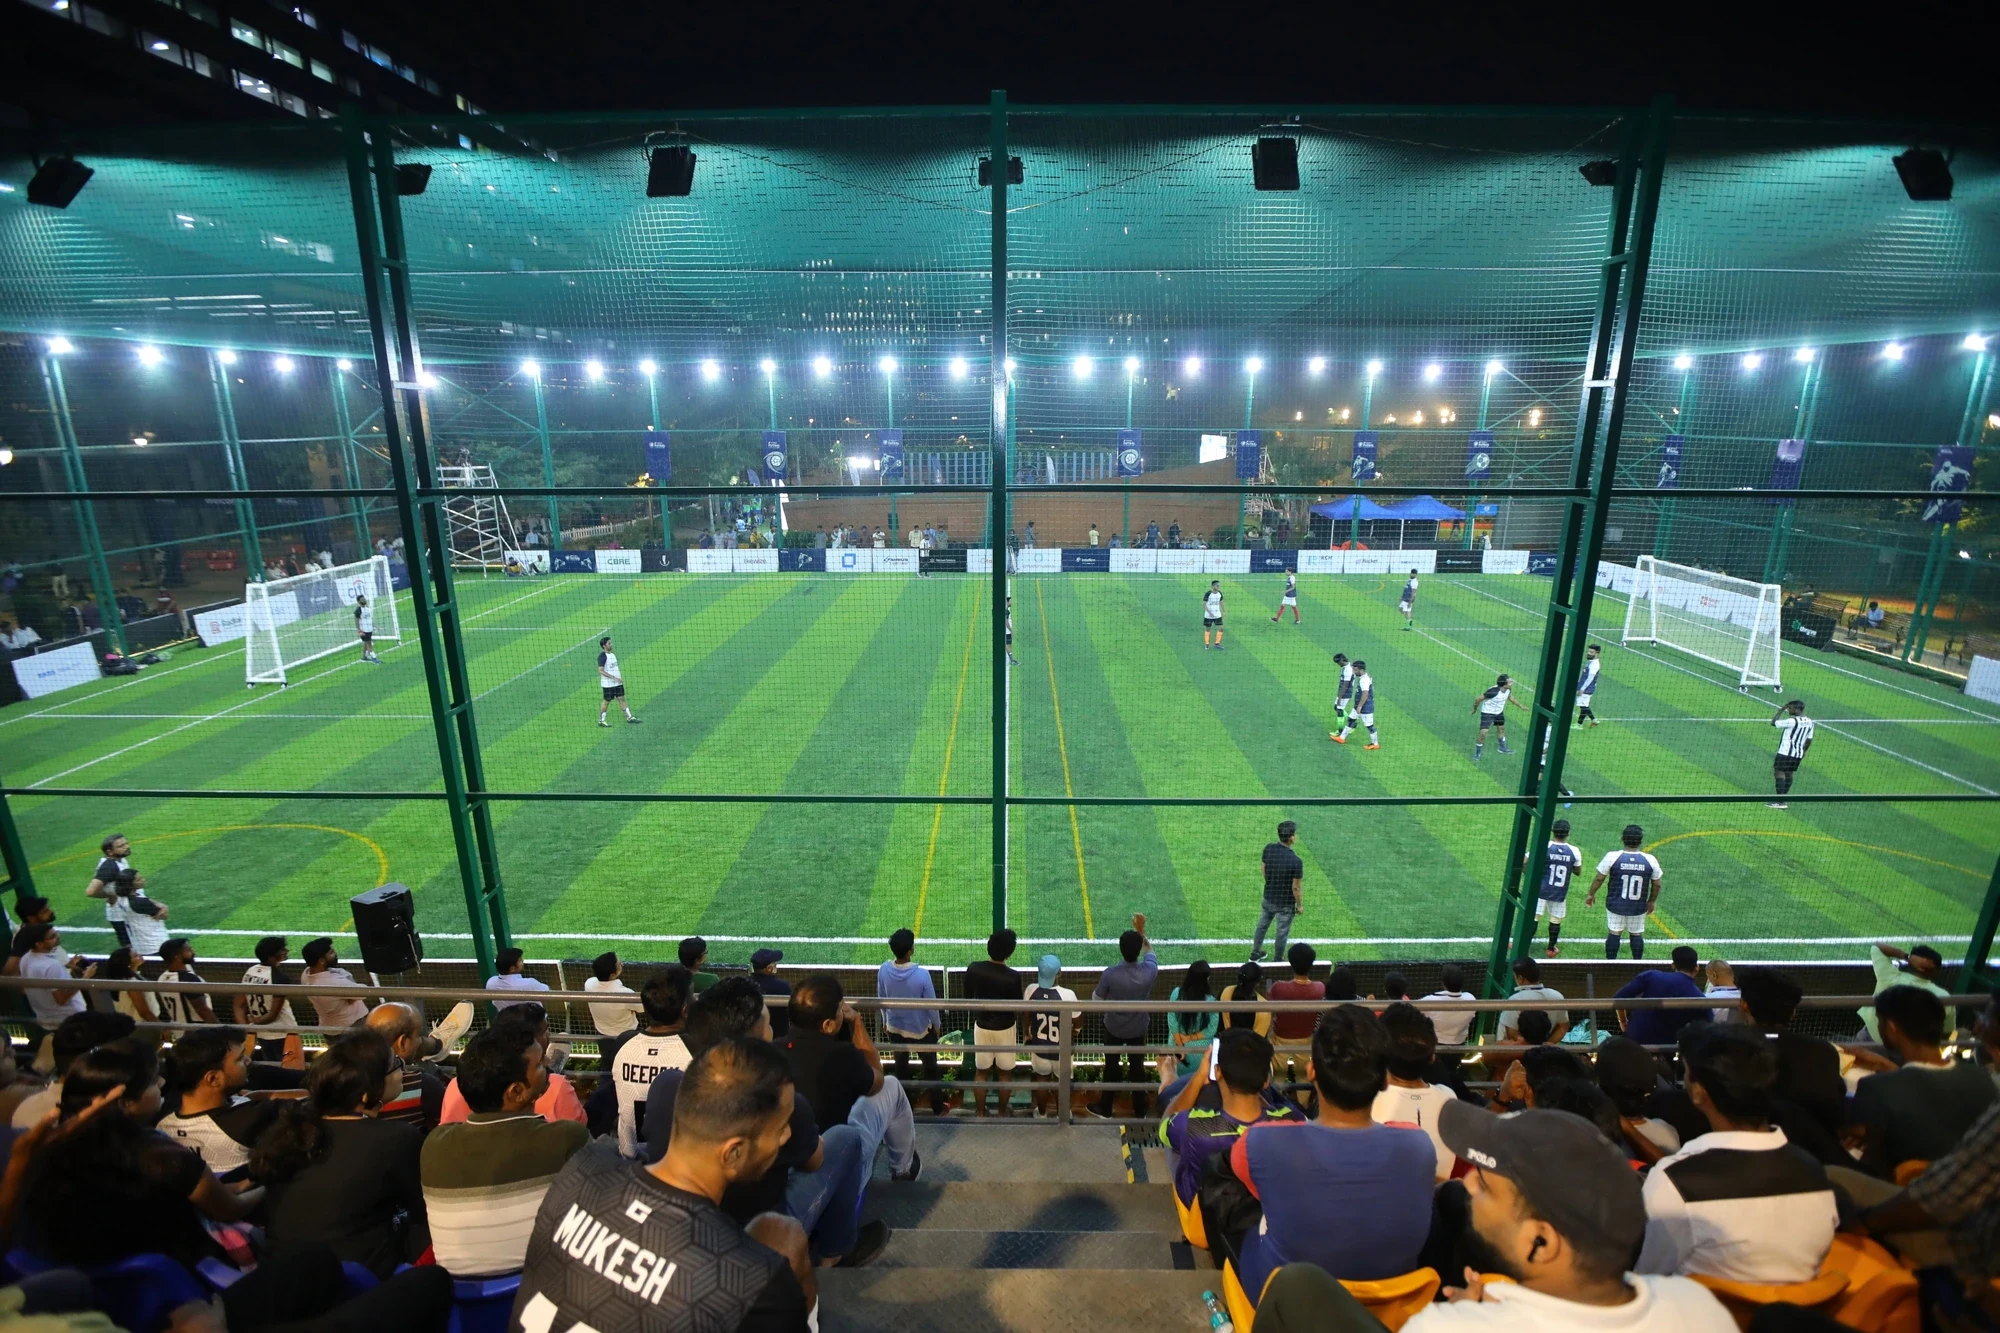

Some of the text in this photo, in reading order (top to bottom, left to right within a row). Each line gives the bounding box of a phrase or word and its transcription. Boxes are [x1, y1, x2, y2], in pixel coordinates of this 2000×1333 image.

[1548, 864, 1567, 887] 19
[1621, 874, 1643, 900] 10
[1036, 1013, 1060, 1043] 26
[1467, 1148, 1497, 1169] POLO
[552, 1203, 677, 1305] MUKESH
